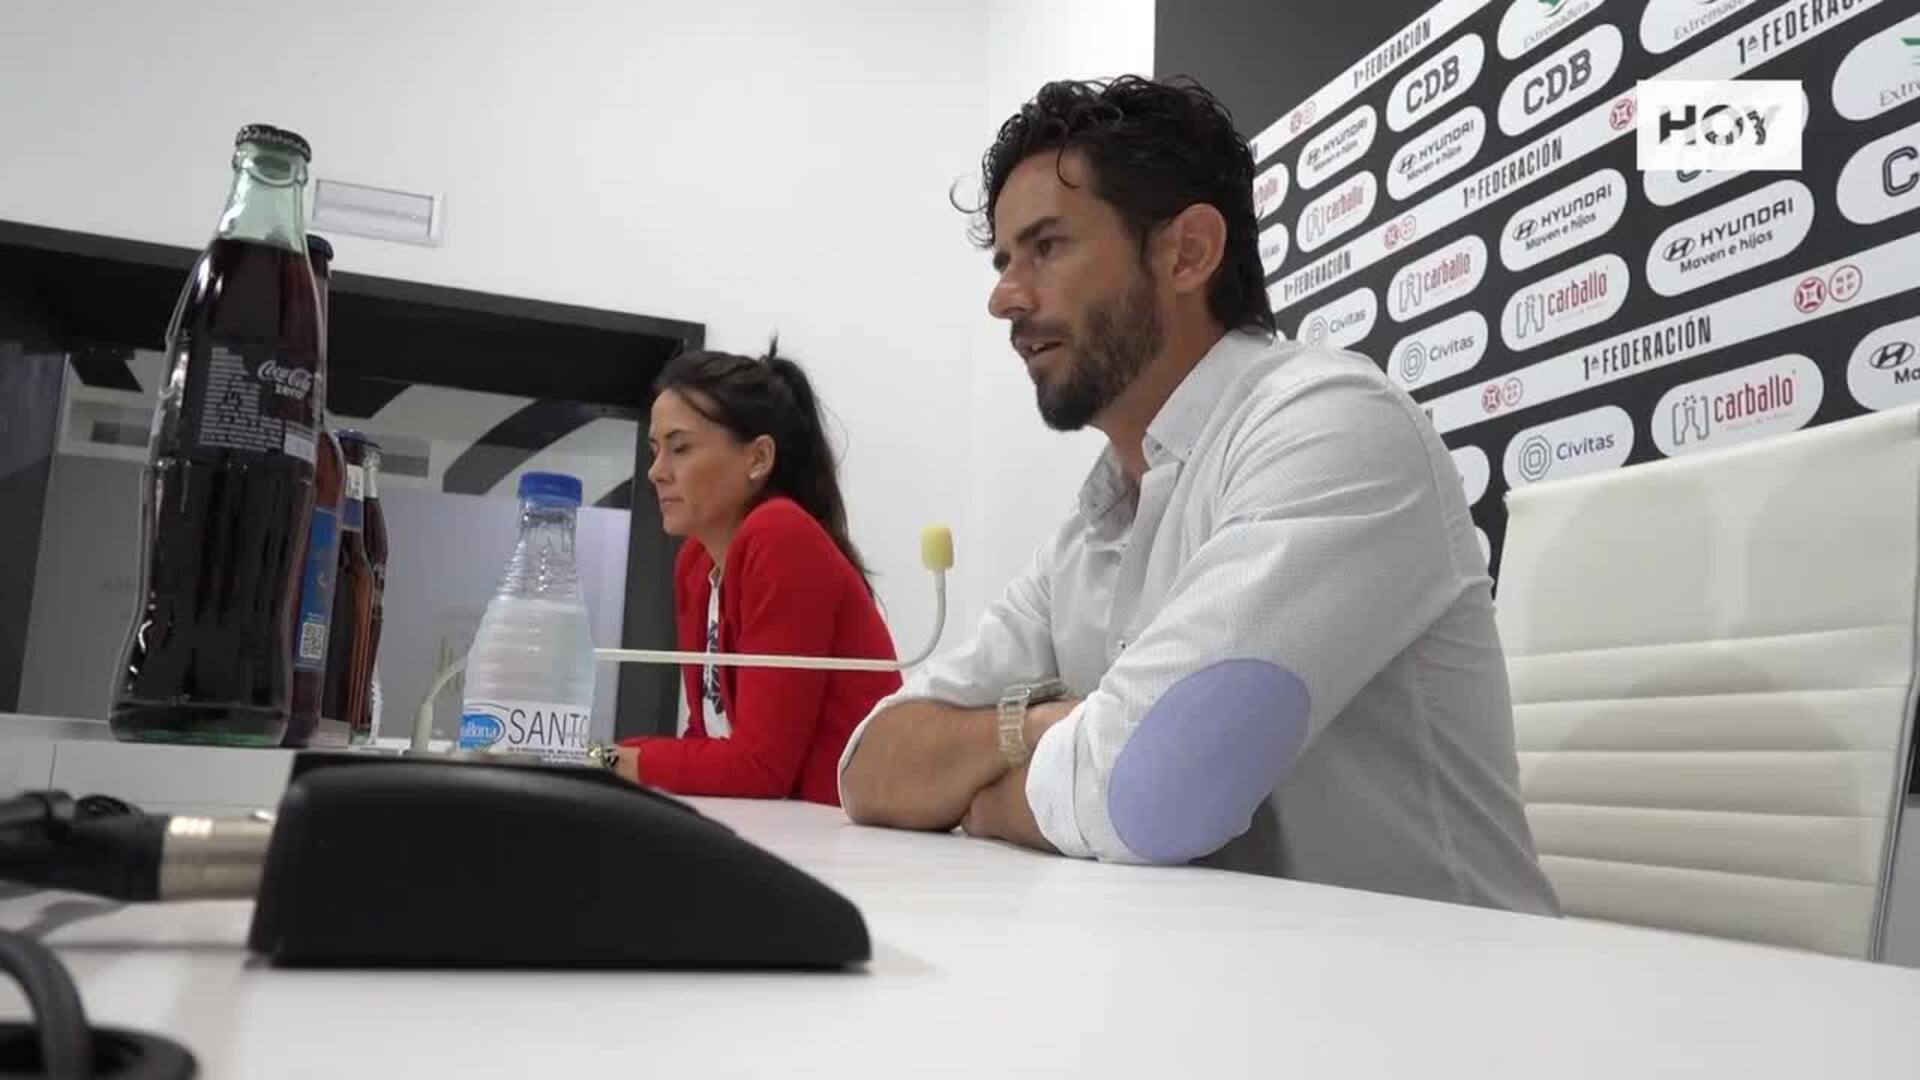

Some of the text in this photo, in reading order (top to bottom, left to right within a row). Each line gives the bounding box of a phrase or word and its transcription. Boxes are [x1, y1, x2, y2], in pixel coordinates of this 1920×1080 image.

[1406, 55, 1460, 114] CDB
[1523, 48, 1592, 116] CDB
[1419, 120, 1474, 161] HYUNDAI
[1541, 184, 1612, 227] HYUNDAI
[1701, 197, 1794, 247] HYUNDAI
[1728, 245, 1737, 256] e
[1739, 229, 1774, 251] hijos
[1424, 251, 1471, 292] carballo
[1547, 270, 1608, 316] carballo
[1429, 335, 1475, 362] Civitas
[1602, 314, 1712, 375] FEDERACIÓN
[1713, 374, 1794, 424] carballo
[1556, 434, 1616, 461] Civitas
